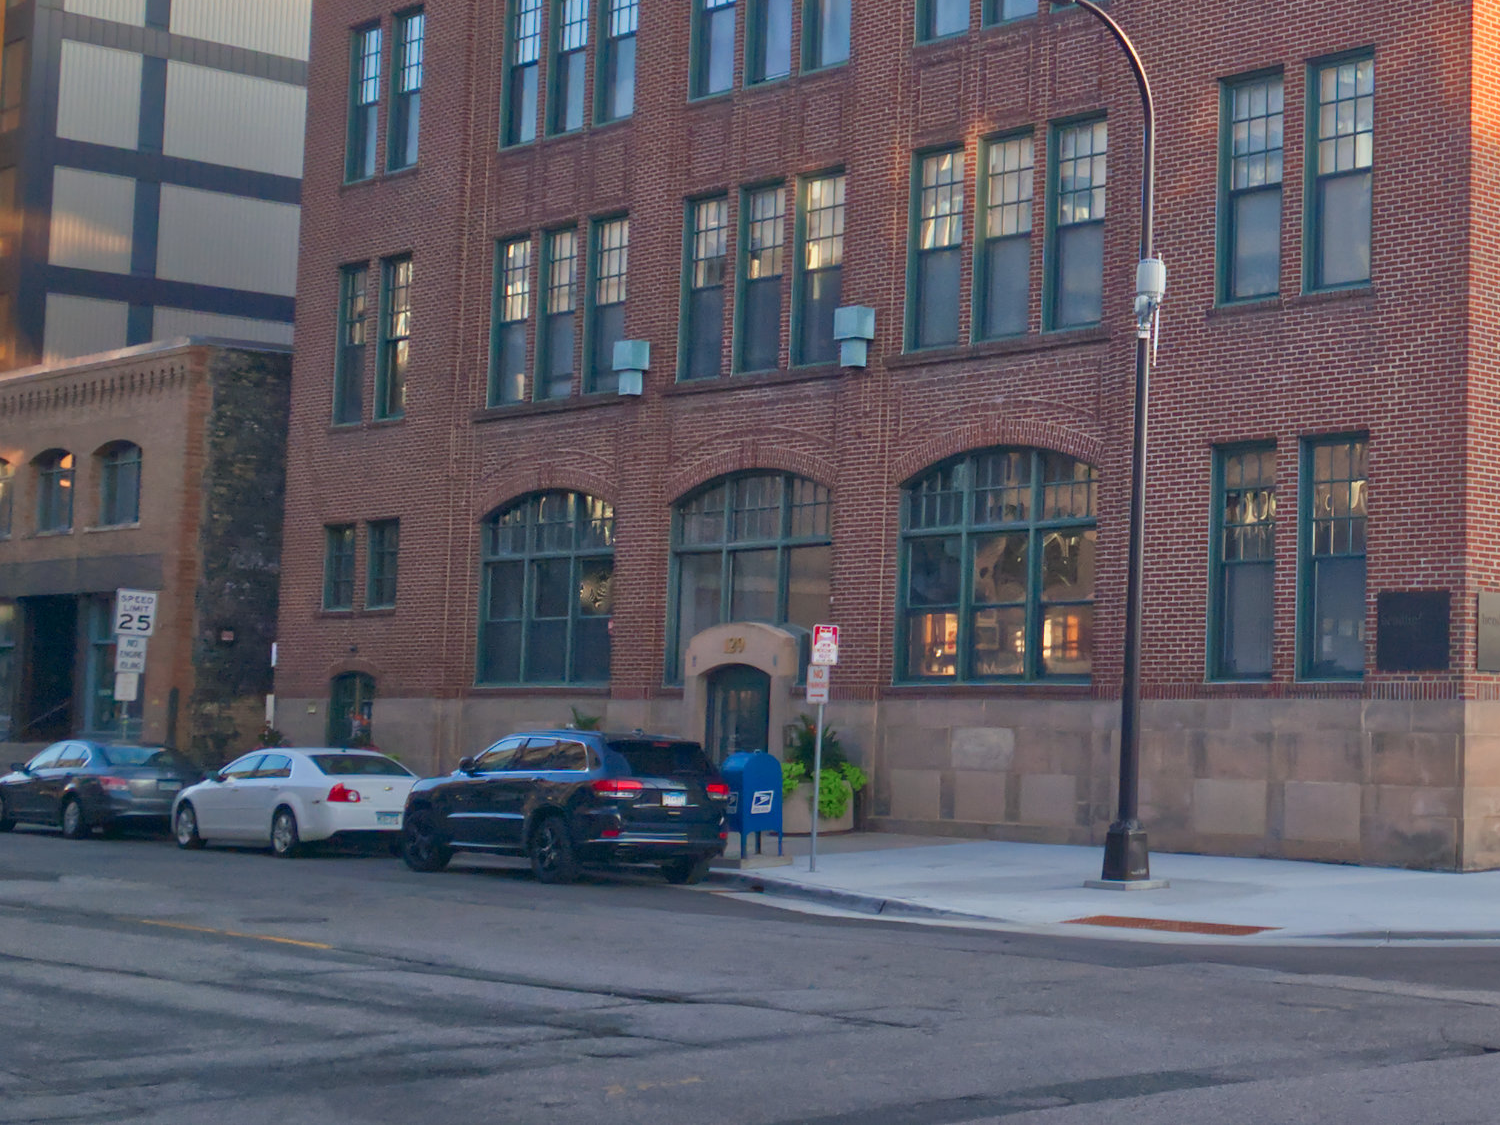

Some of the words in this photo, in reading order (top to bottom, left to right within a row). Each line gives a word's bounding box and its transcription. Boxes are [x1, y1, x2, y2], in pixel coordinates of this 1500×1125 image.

[121, 595, 154, 604] SPEED
[119, 613, 150, 631] 25
[127, 639, 138, 648] NO
[813, 669, 823, 679] NO
